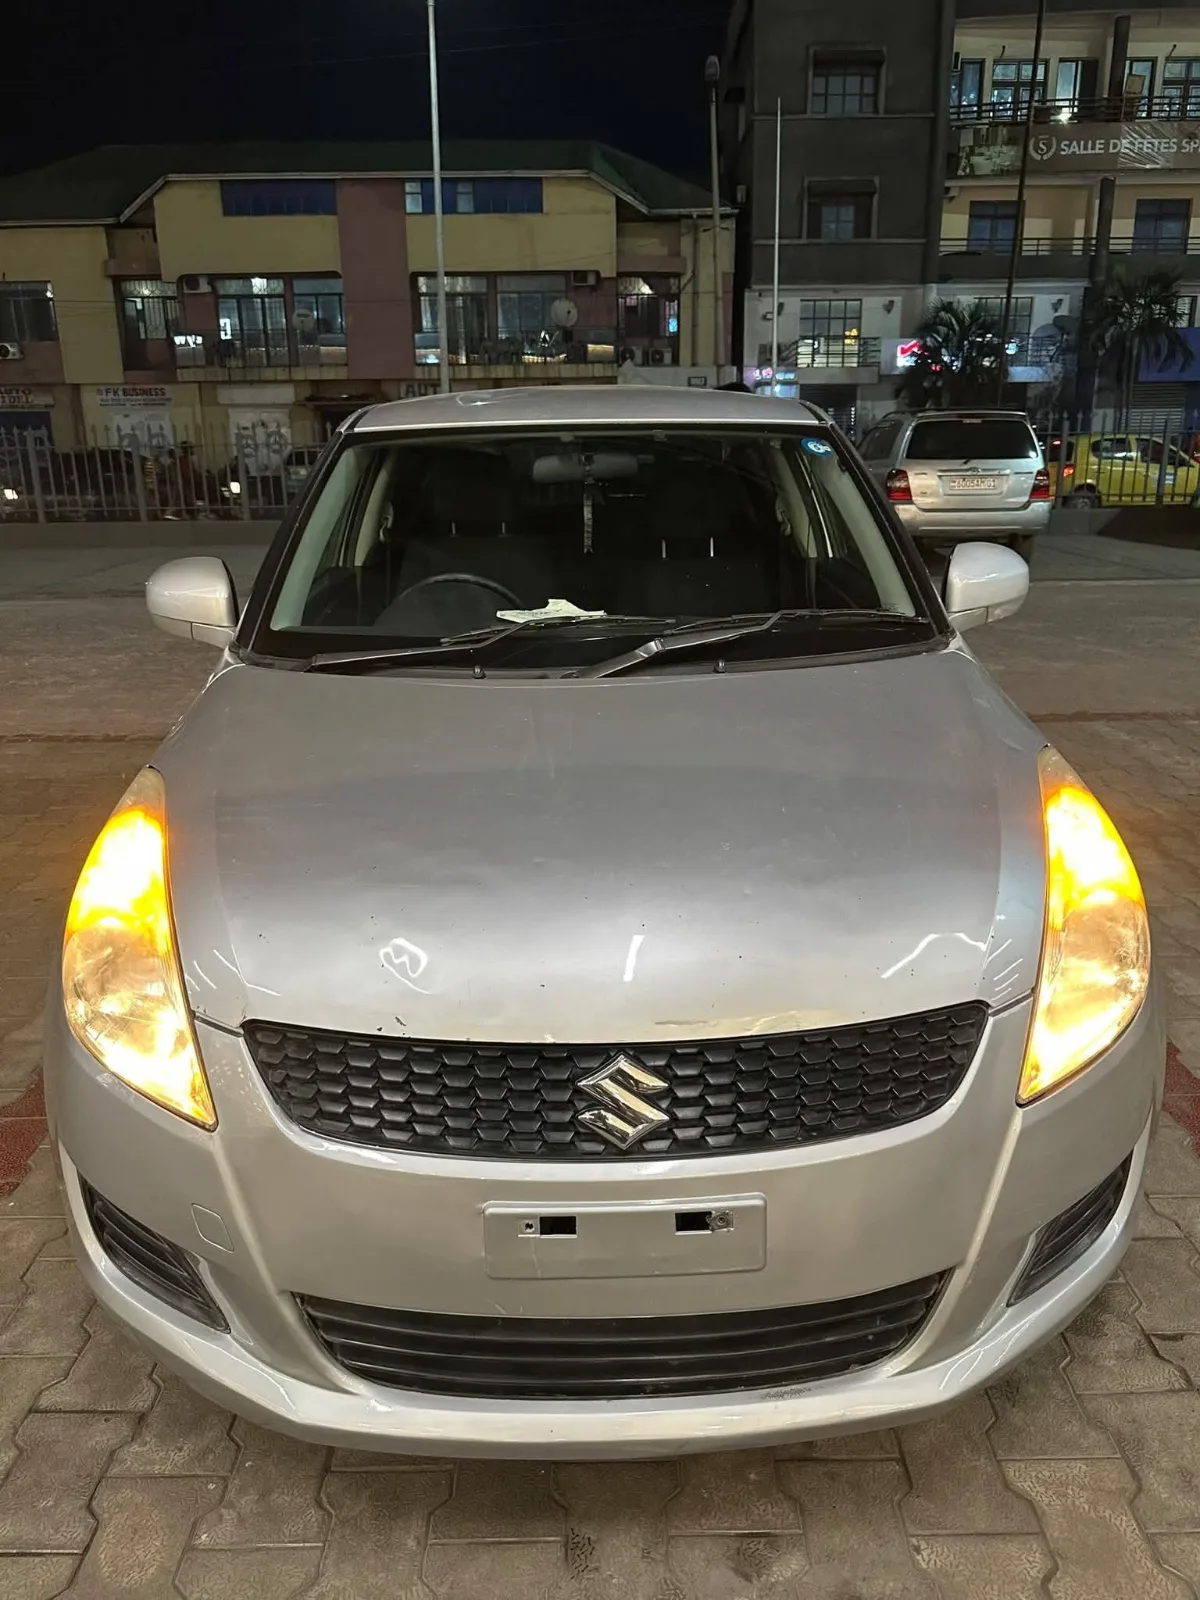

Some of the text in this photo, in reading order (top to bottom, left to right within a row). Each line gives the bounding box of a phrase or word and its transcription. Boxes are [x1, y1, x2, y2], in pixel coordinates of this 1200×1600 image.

[1060, 139, 1105, 155] SALLE
[1108, 138, 1129, 153] DE
[1181, 138, 1200, 153] SP
[105, 387, 120, 397] FK
[122, 387, 166, 397] BUSINESS
